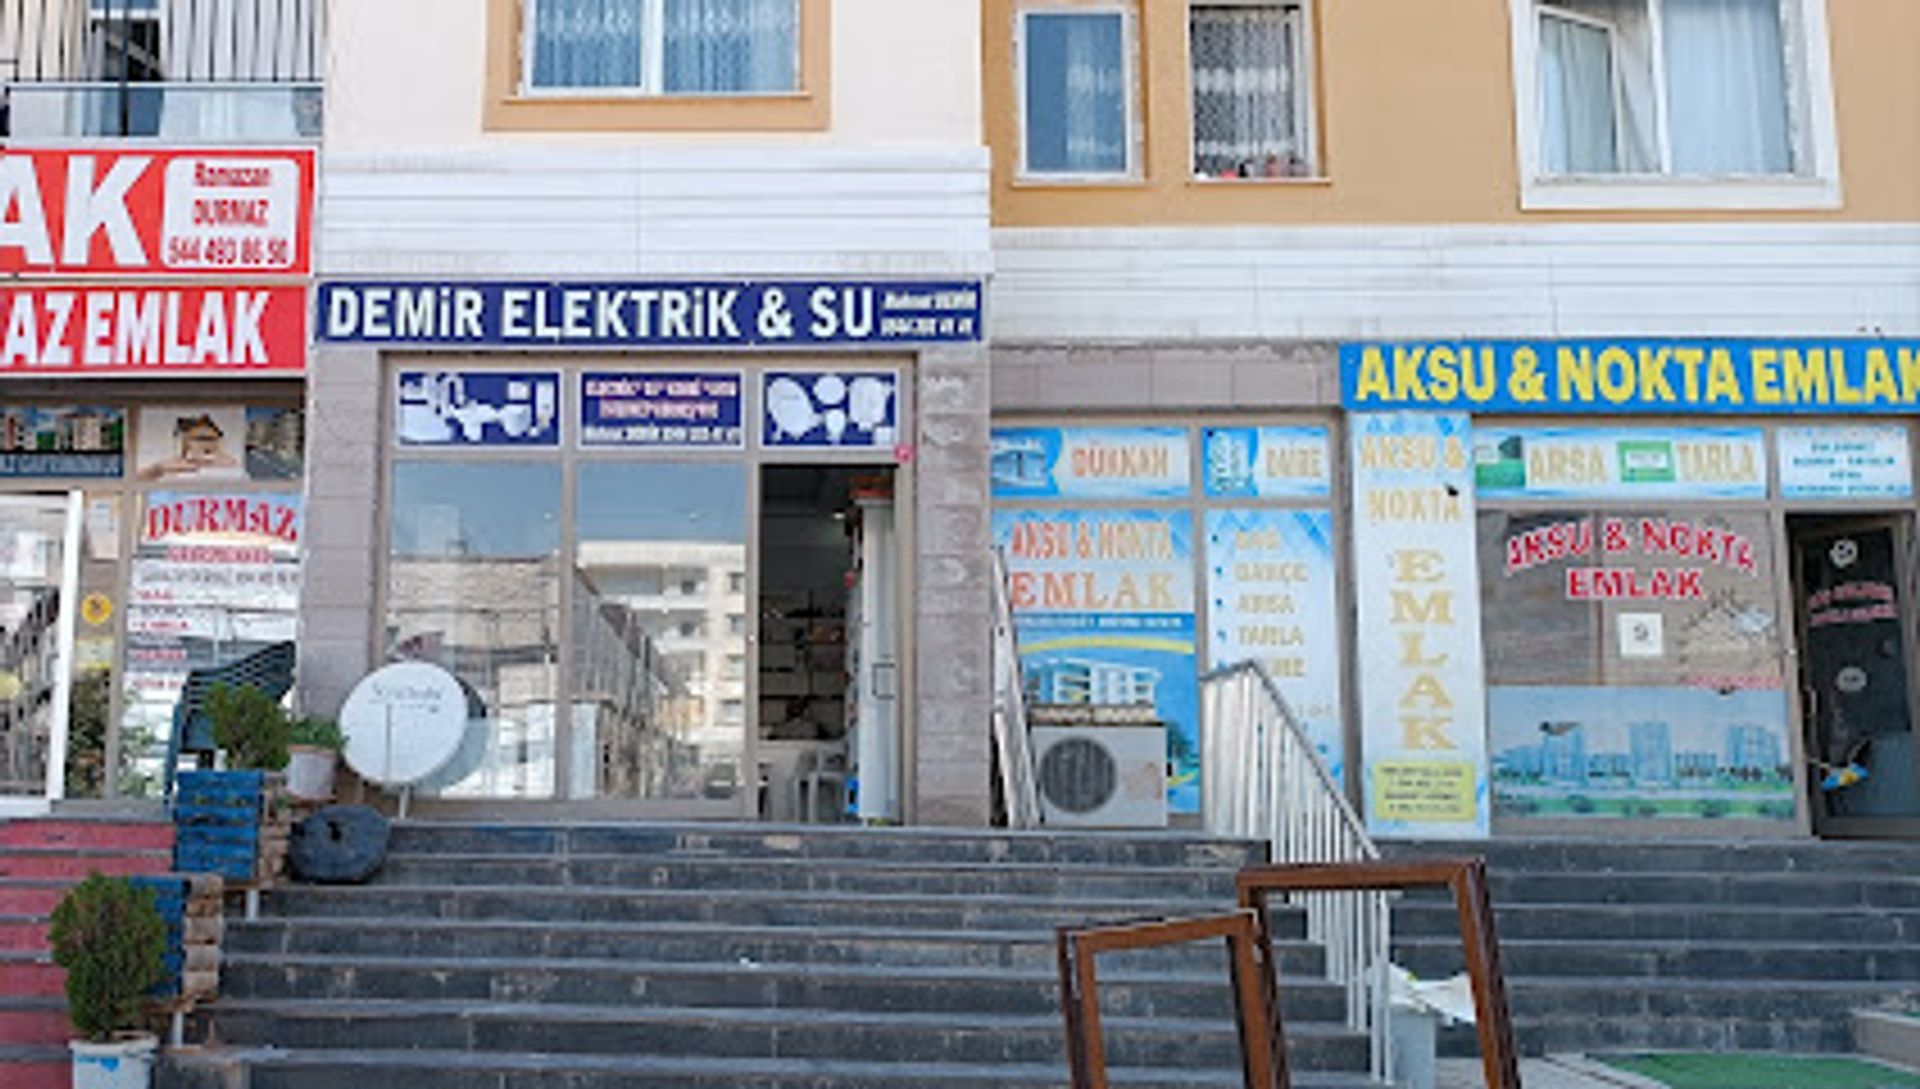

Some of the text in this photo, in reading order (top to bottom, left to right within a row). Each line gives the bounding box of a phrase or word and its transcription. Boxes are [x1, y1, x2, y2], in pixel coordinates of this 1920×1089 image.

[0, 155, 155, 265] AK
[193, 199, 269, 226] DURMAZ
[757, 288, 794, 338] &
[811, 287, 874, 338] SU
[1356, 346, 1496, 402] AKSU
[1507, 347, 1547, 402] &
[1556, 347, 1744, 403] NOKTA
[1361, 435, 1465, 470] AKSU &
[1530, 443, 1757, 485] ARSA TARLA
[147, 497, 298, 542] DURMAZ
[1366, 487, 1462, 522] NOKTA
[1012, 522, 1068, 560] AKSU
[1099, 522, 1173, 560] NOKTA
[1504, 517, 1758, 577] AKSU & NOKTA
[1012, 572, 1176, 609] EMLAK
[1566, 567, 1706, 600] EMLAK
